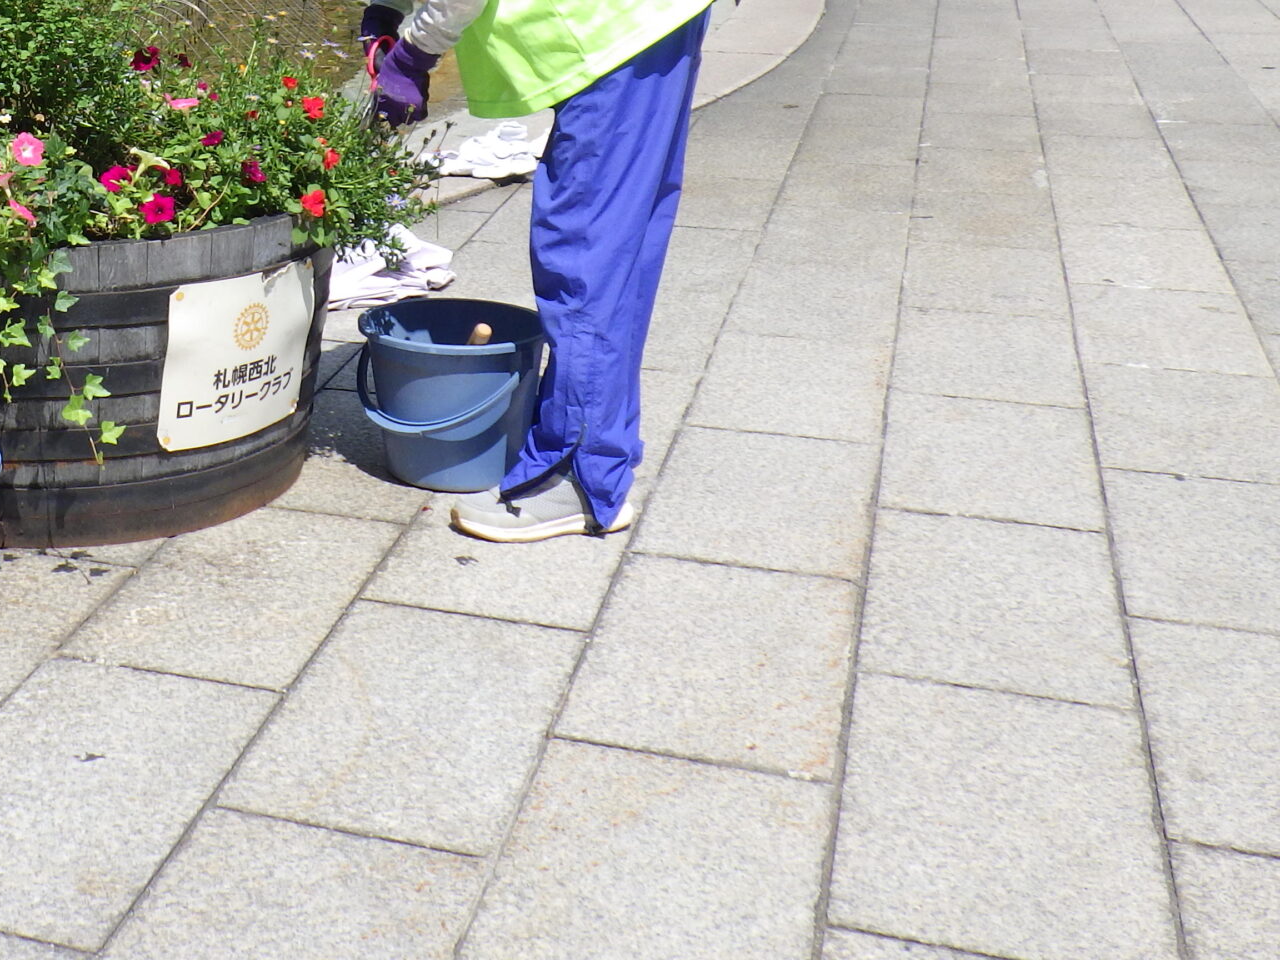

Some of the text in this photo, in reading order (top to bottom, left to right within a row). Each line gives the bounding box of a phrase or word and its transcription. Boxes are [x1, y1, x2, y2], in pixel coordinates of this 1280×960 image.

[176, 367, 294, 419] ロータリークラブ
[213, 355, 277, 390] 札幌西北
